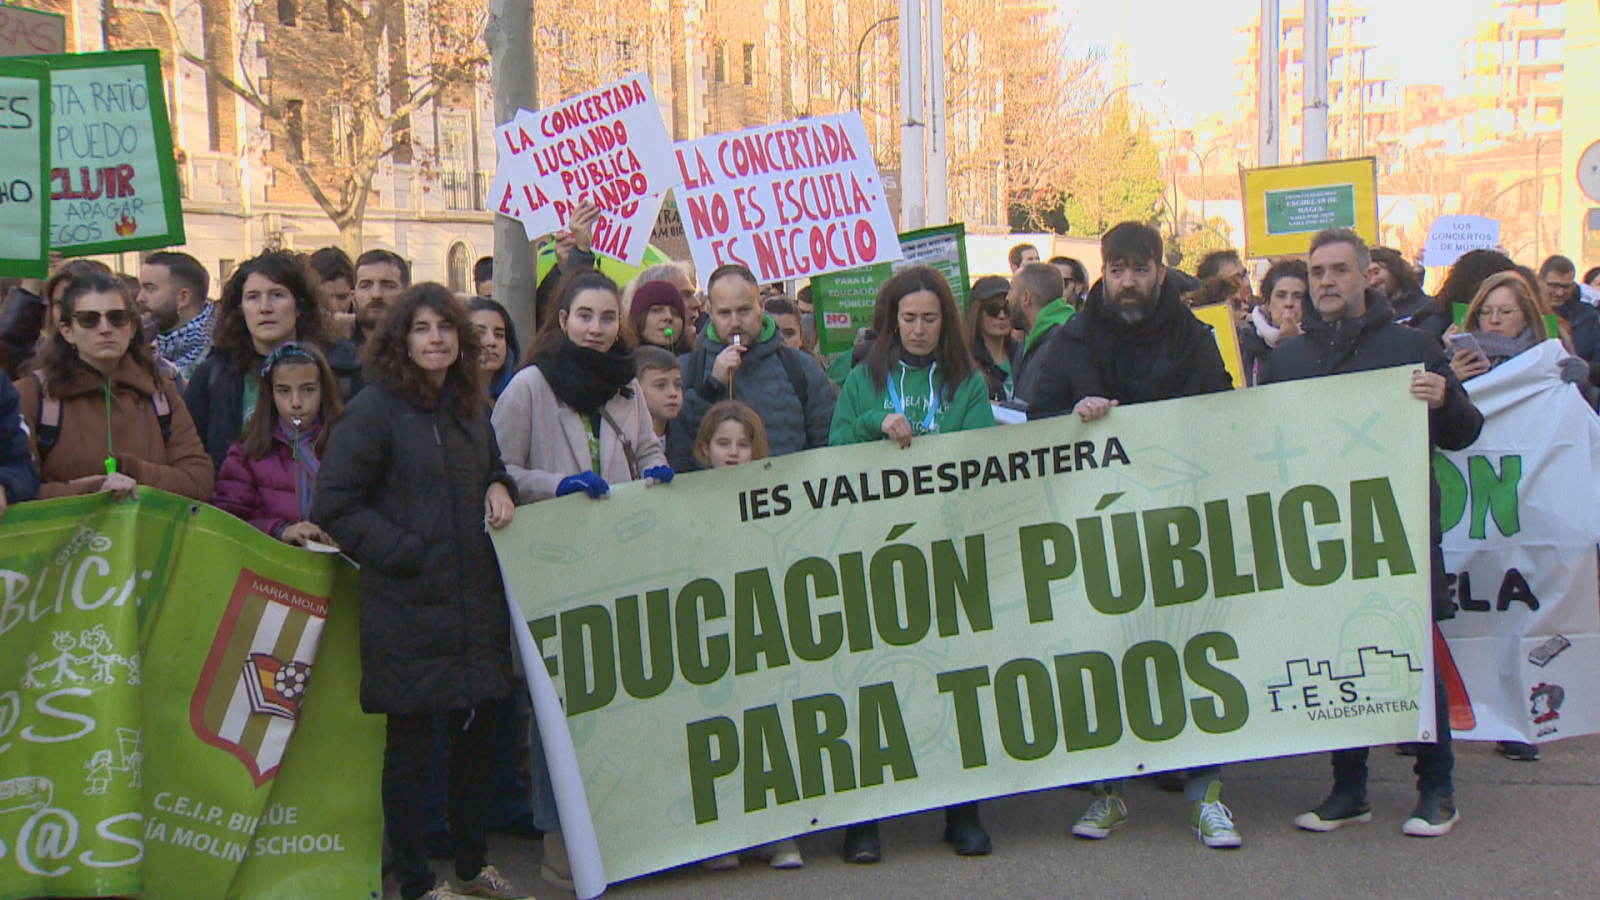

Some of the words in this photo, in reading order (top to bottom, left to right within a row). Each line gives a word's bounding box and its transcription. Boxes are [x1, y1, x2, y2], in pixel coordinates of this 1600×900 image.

[504, 126, 535, 156] LA
[540, 79, 647, 138] CONCERTADA
[57, 122, 138, 160] PUEDO
[532, 119, 628, 177] LUCRANDO
[674, 148, 714, 190] LA
[718, 120, 857, 179] CONCERTADA
[64, 197, 145, 222] APAGAR
[523, 182, 549, 212] LA
[686, 192, 730, 240] NO
[734, 184, 766, 231] ES
[771, 170, 877, 226] ESCUELA:
[1452, 222, 1471, 231] LOS
[1440, 243, 1453, 251] DE
[826, 313, 849, 325] NO
[740, 484, 792, 522] IES
[803, 436, 1131, 510] VALDESPARTERA
[1019, 477, 1417, 624] PÚBLICA
[252, 580, 289, 602] MARIA
[1267, 681, 1371, 713] I.E.S.
[1307, 699, 1419, 721] VALDESPARTERA
[686, 681, 918, 826] PARA
[937, 631, 1250, 769] TODOS
[154, 791, 223, 826] C.E.I.P.
[255, 833, 345, 857] SCHOOL
